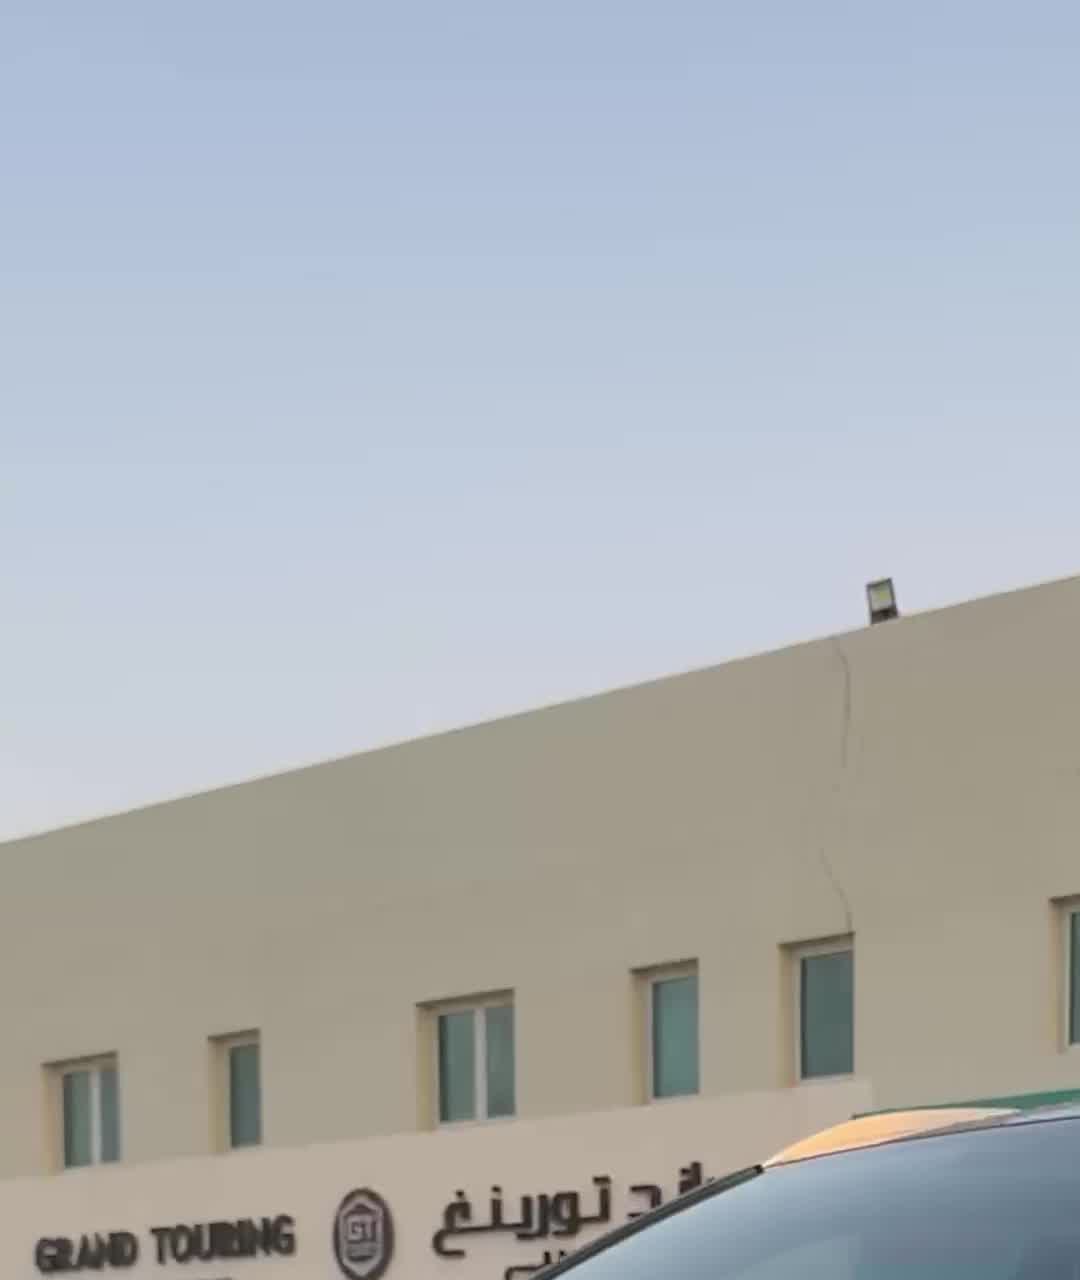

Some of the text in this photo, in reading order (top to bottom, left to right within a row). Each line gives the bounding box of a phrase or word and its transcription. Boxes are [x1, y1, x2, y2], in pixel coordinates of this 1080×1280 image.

[34, 1213, 297, 1275] GRAND TOURING
[347, 1214, 376, 1241] GT
